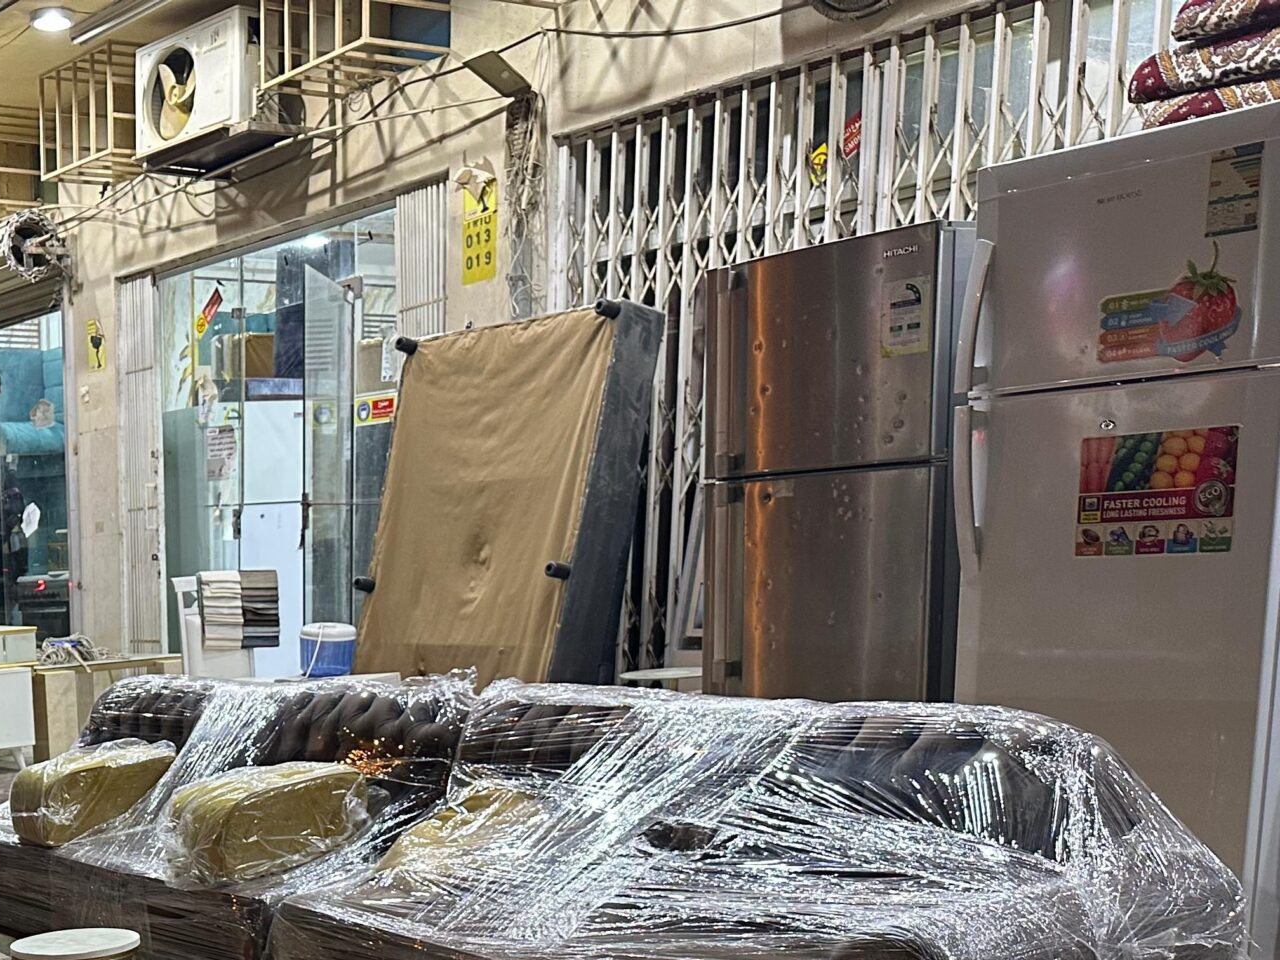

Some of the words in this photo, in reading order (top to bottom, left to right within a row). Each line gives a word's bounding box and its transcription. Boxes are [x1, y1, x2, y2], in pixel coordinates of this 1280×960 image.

[465, 228, 491, 249] 013
[883, 244, 919, 259] HITACHI
[465, 251, 492, 270] 019
[1198, 486, 1221, 502] ECO
[1103, 499, 1140, 510] FASTER
[1143, 496, 1187, 507] COOLING
[1102, 510, 1120, 518] LONG
[1120, 508, 1148, 518] LASTING
[1148, 506, 1186, 517] FRESHNESS
